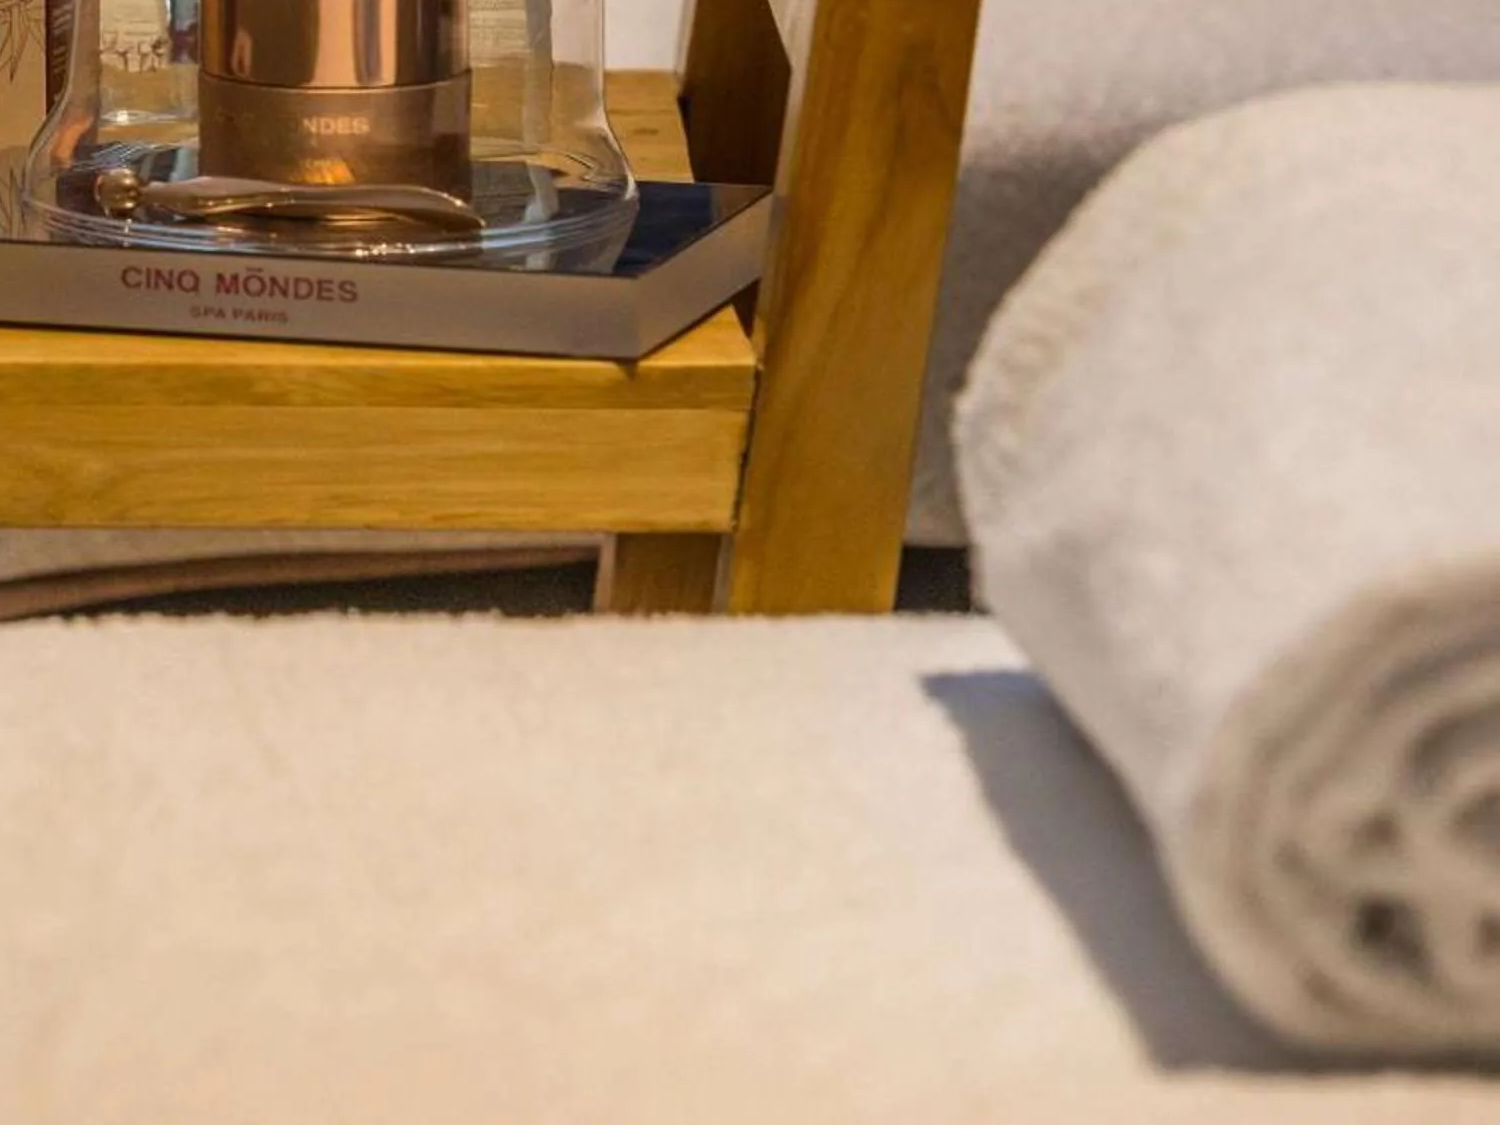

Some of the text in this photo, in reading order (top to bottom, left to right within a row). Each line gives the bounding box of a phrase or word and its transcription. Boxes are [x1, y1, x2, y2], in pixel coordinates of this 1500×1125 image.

[302, 116, 371, 136] NDES
[120, 265, 200, 293] CINQ
[189, 305, 289, 325] SPA PARIS
